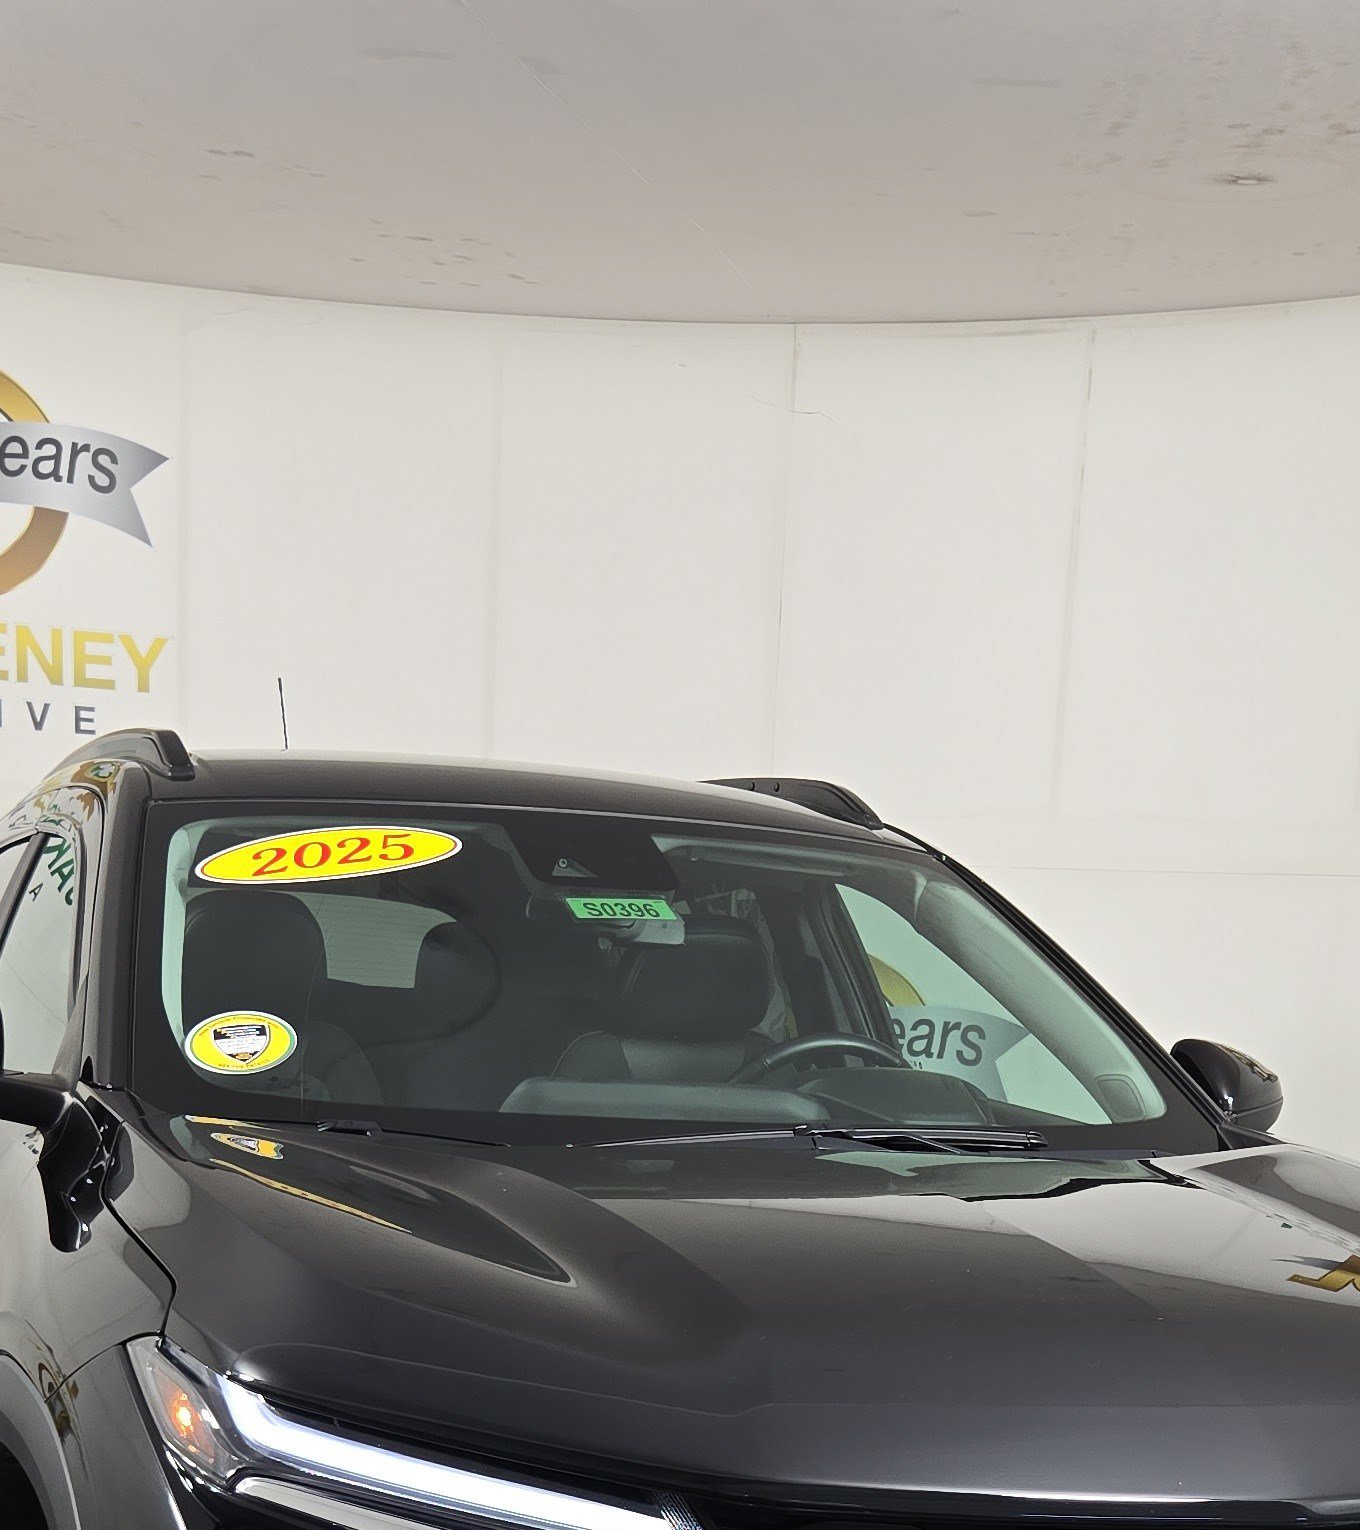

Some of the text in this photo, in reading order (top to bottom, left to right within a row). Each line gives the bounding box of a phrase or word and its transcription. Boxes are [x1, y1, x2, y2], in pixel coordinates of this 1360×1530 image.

[251, 833, 416, 877] 2025
[582, 902, 661, 918] S0396
[890, 1017, 987, 1067] ears
